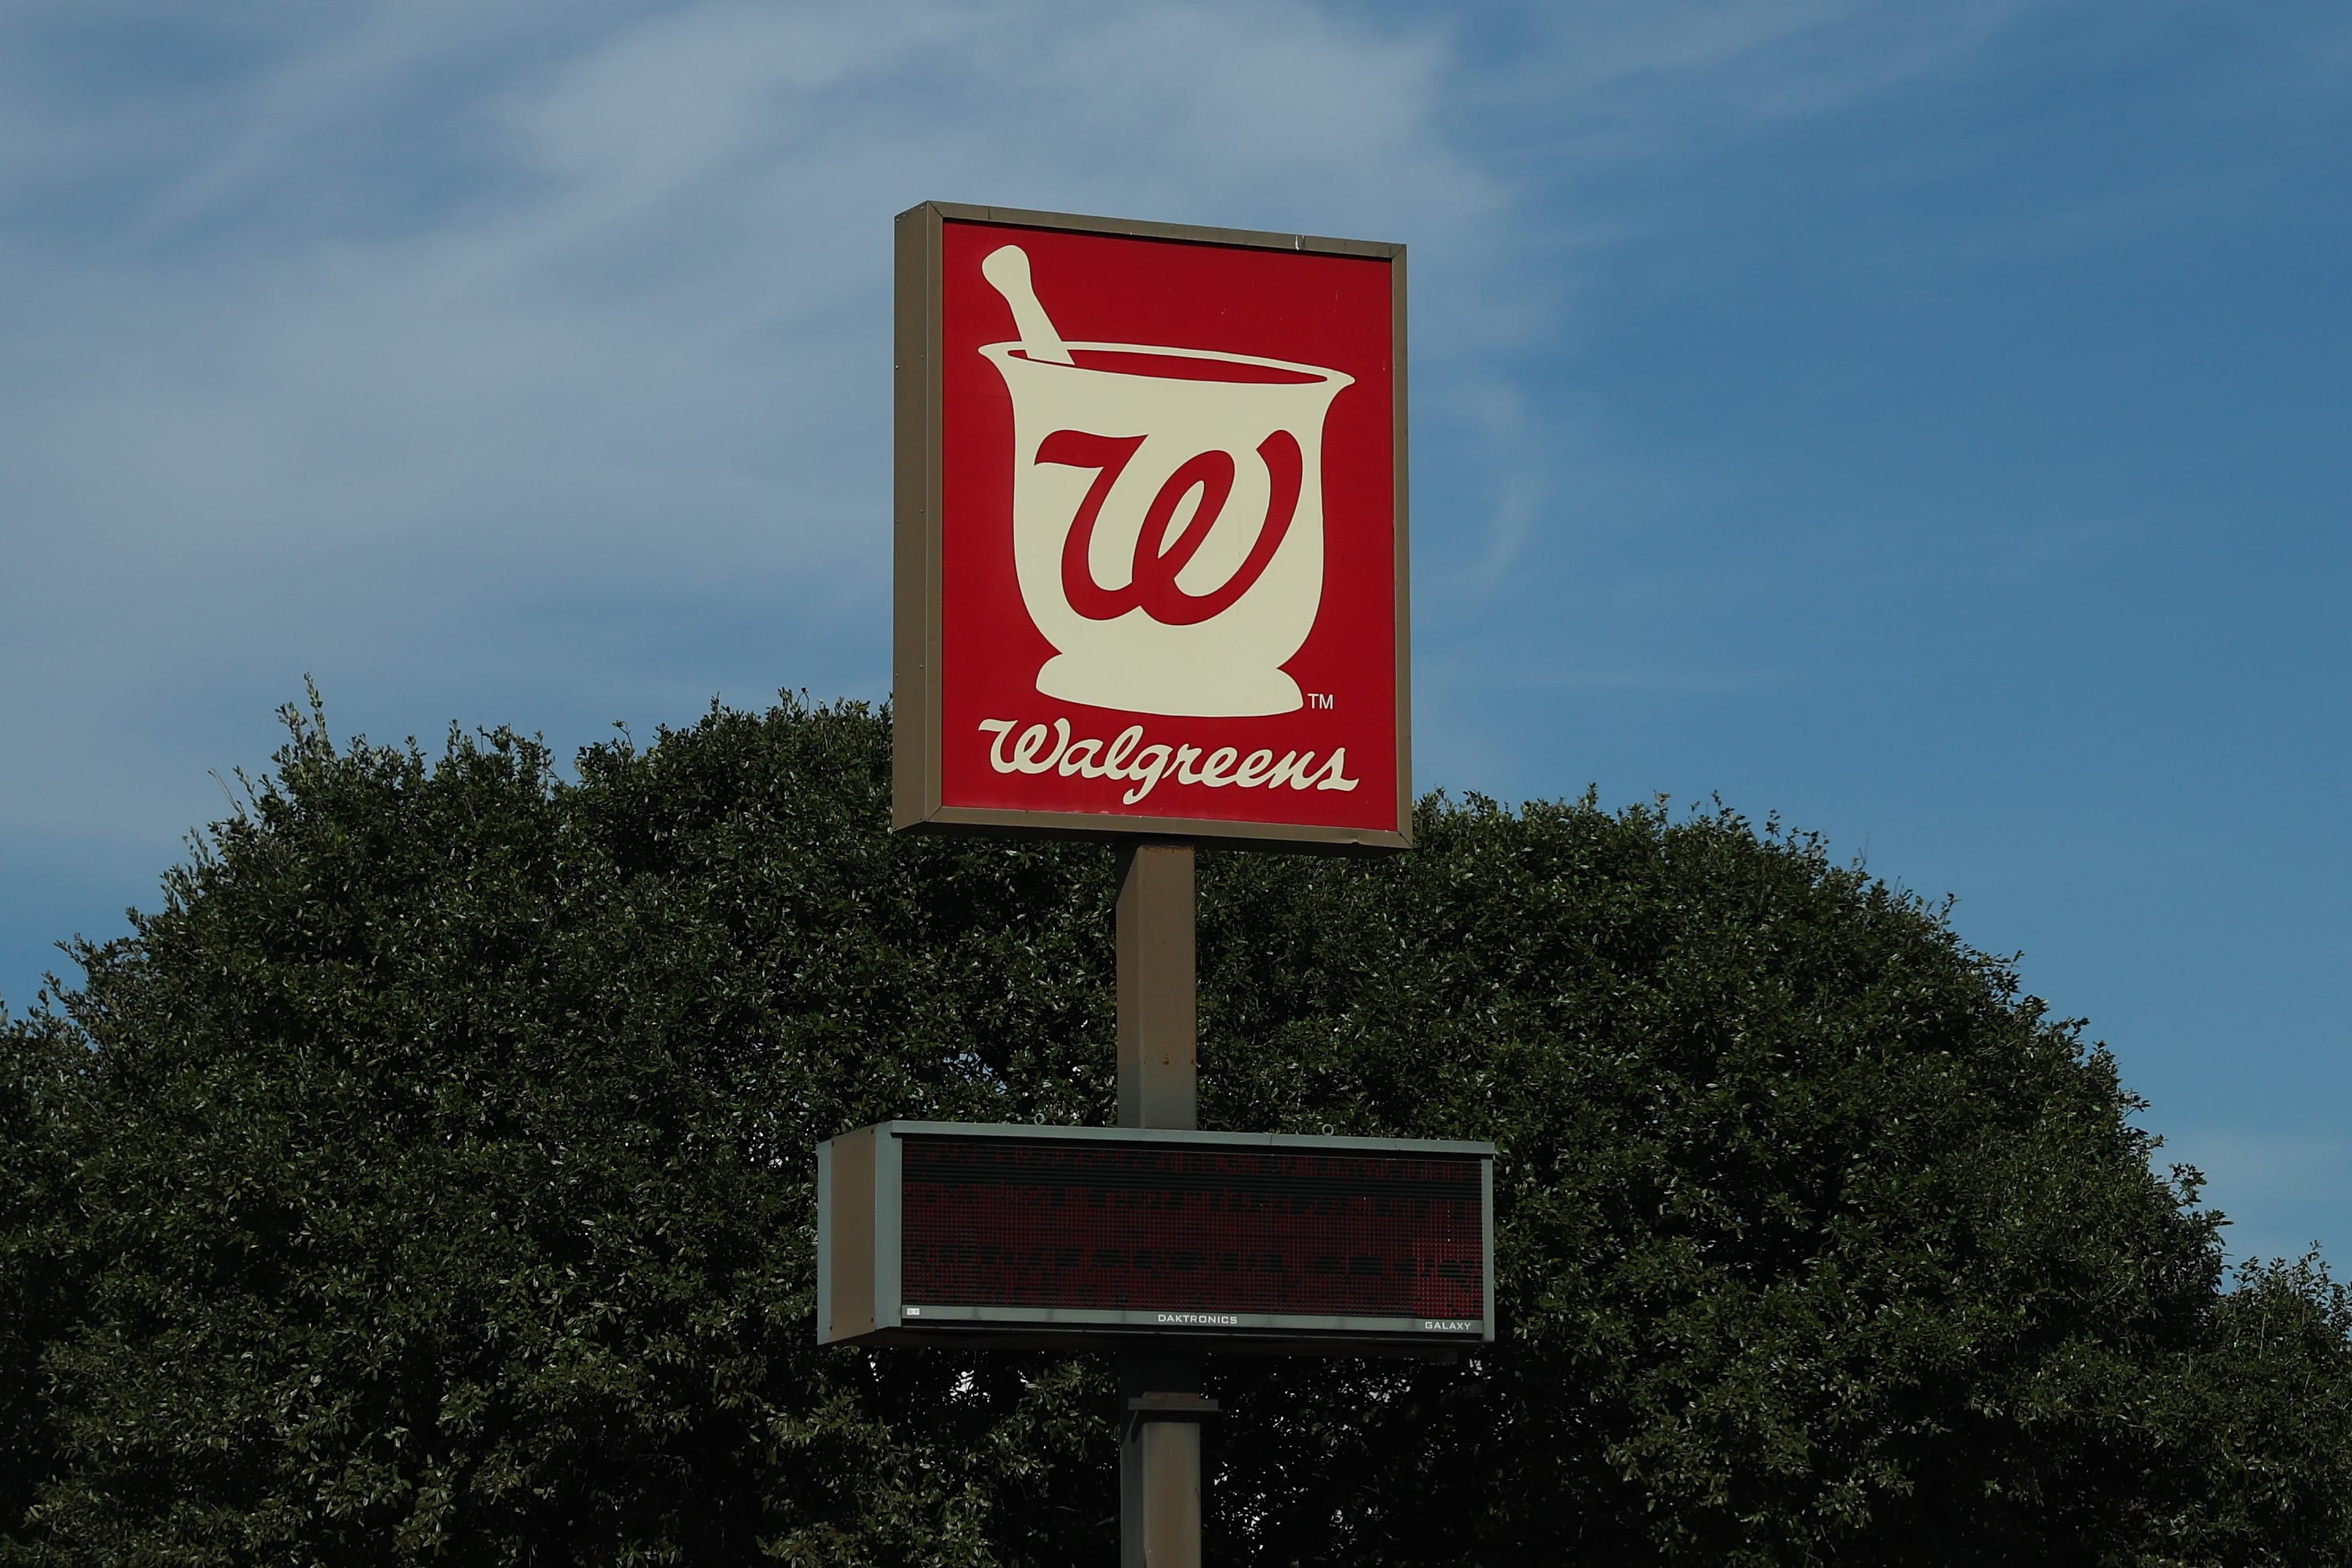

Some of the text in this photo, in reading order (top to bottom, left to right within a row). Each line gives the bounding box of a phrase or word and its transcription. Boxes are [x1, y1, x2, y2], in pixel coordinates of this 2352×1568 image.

[1034, 429, 1303, 625] W
[1307, 693, 1333, 710] TM
[978, 717, 1359, 805] Walgreens
[1158, 1314, 1238, 1324] DAKTRONICS
[1424, 1321, 1471, 1330] GALAXY
